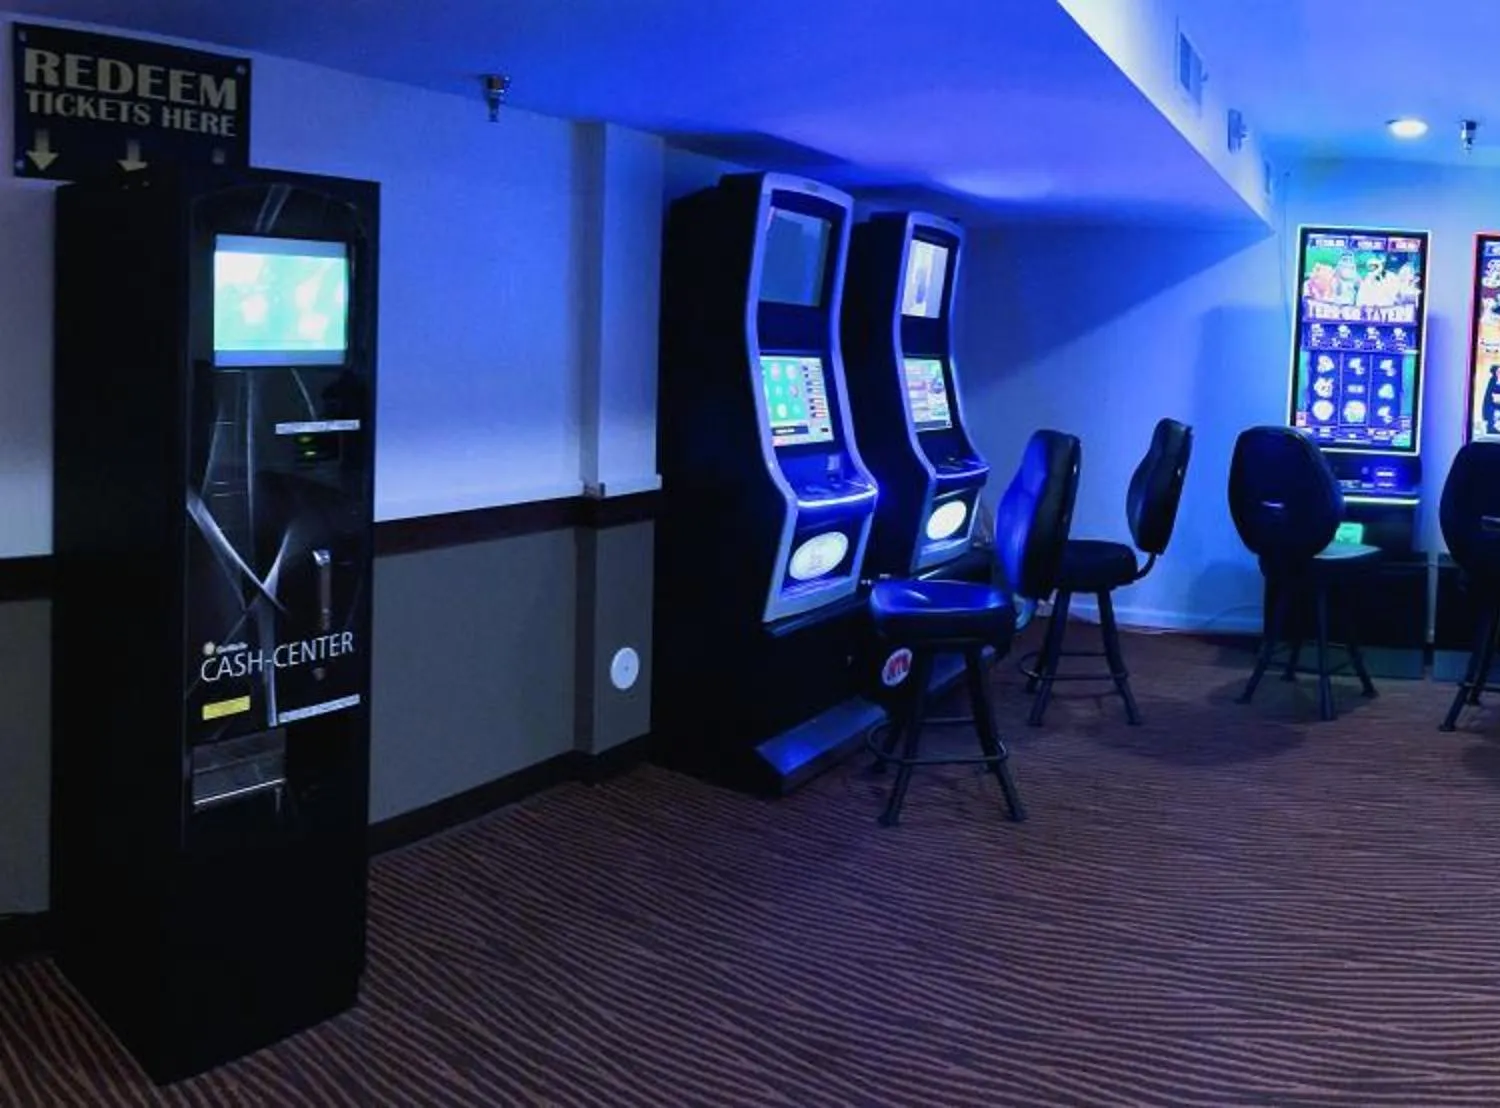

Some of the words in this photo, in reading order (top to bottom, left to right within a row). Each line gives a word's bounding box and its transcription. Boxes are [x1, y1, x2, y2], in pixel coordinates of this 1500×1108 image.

[24, 47, 237, 110] REDEEM
[26, 89, 151, 125] TICKETS
[161, 107, 237, 137] HERE
[201, 632, 354, 682] CASH-CENTER
